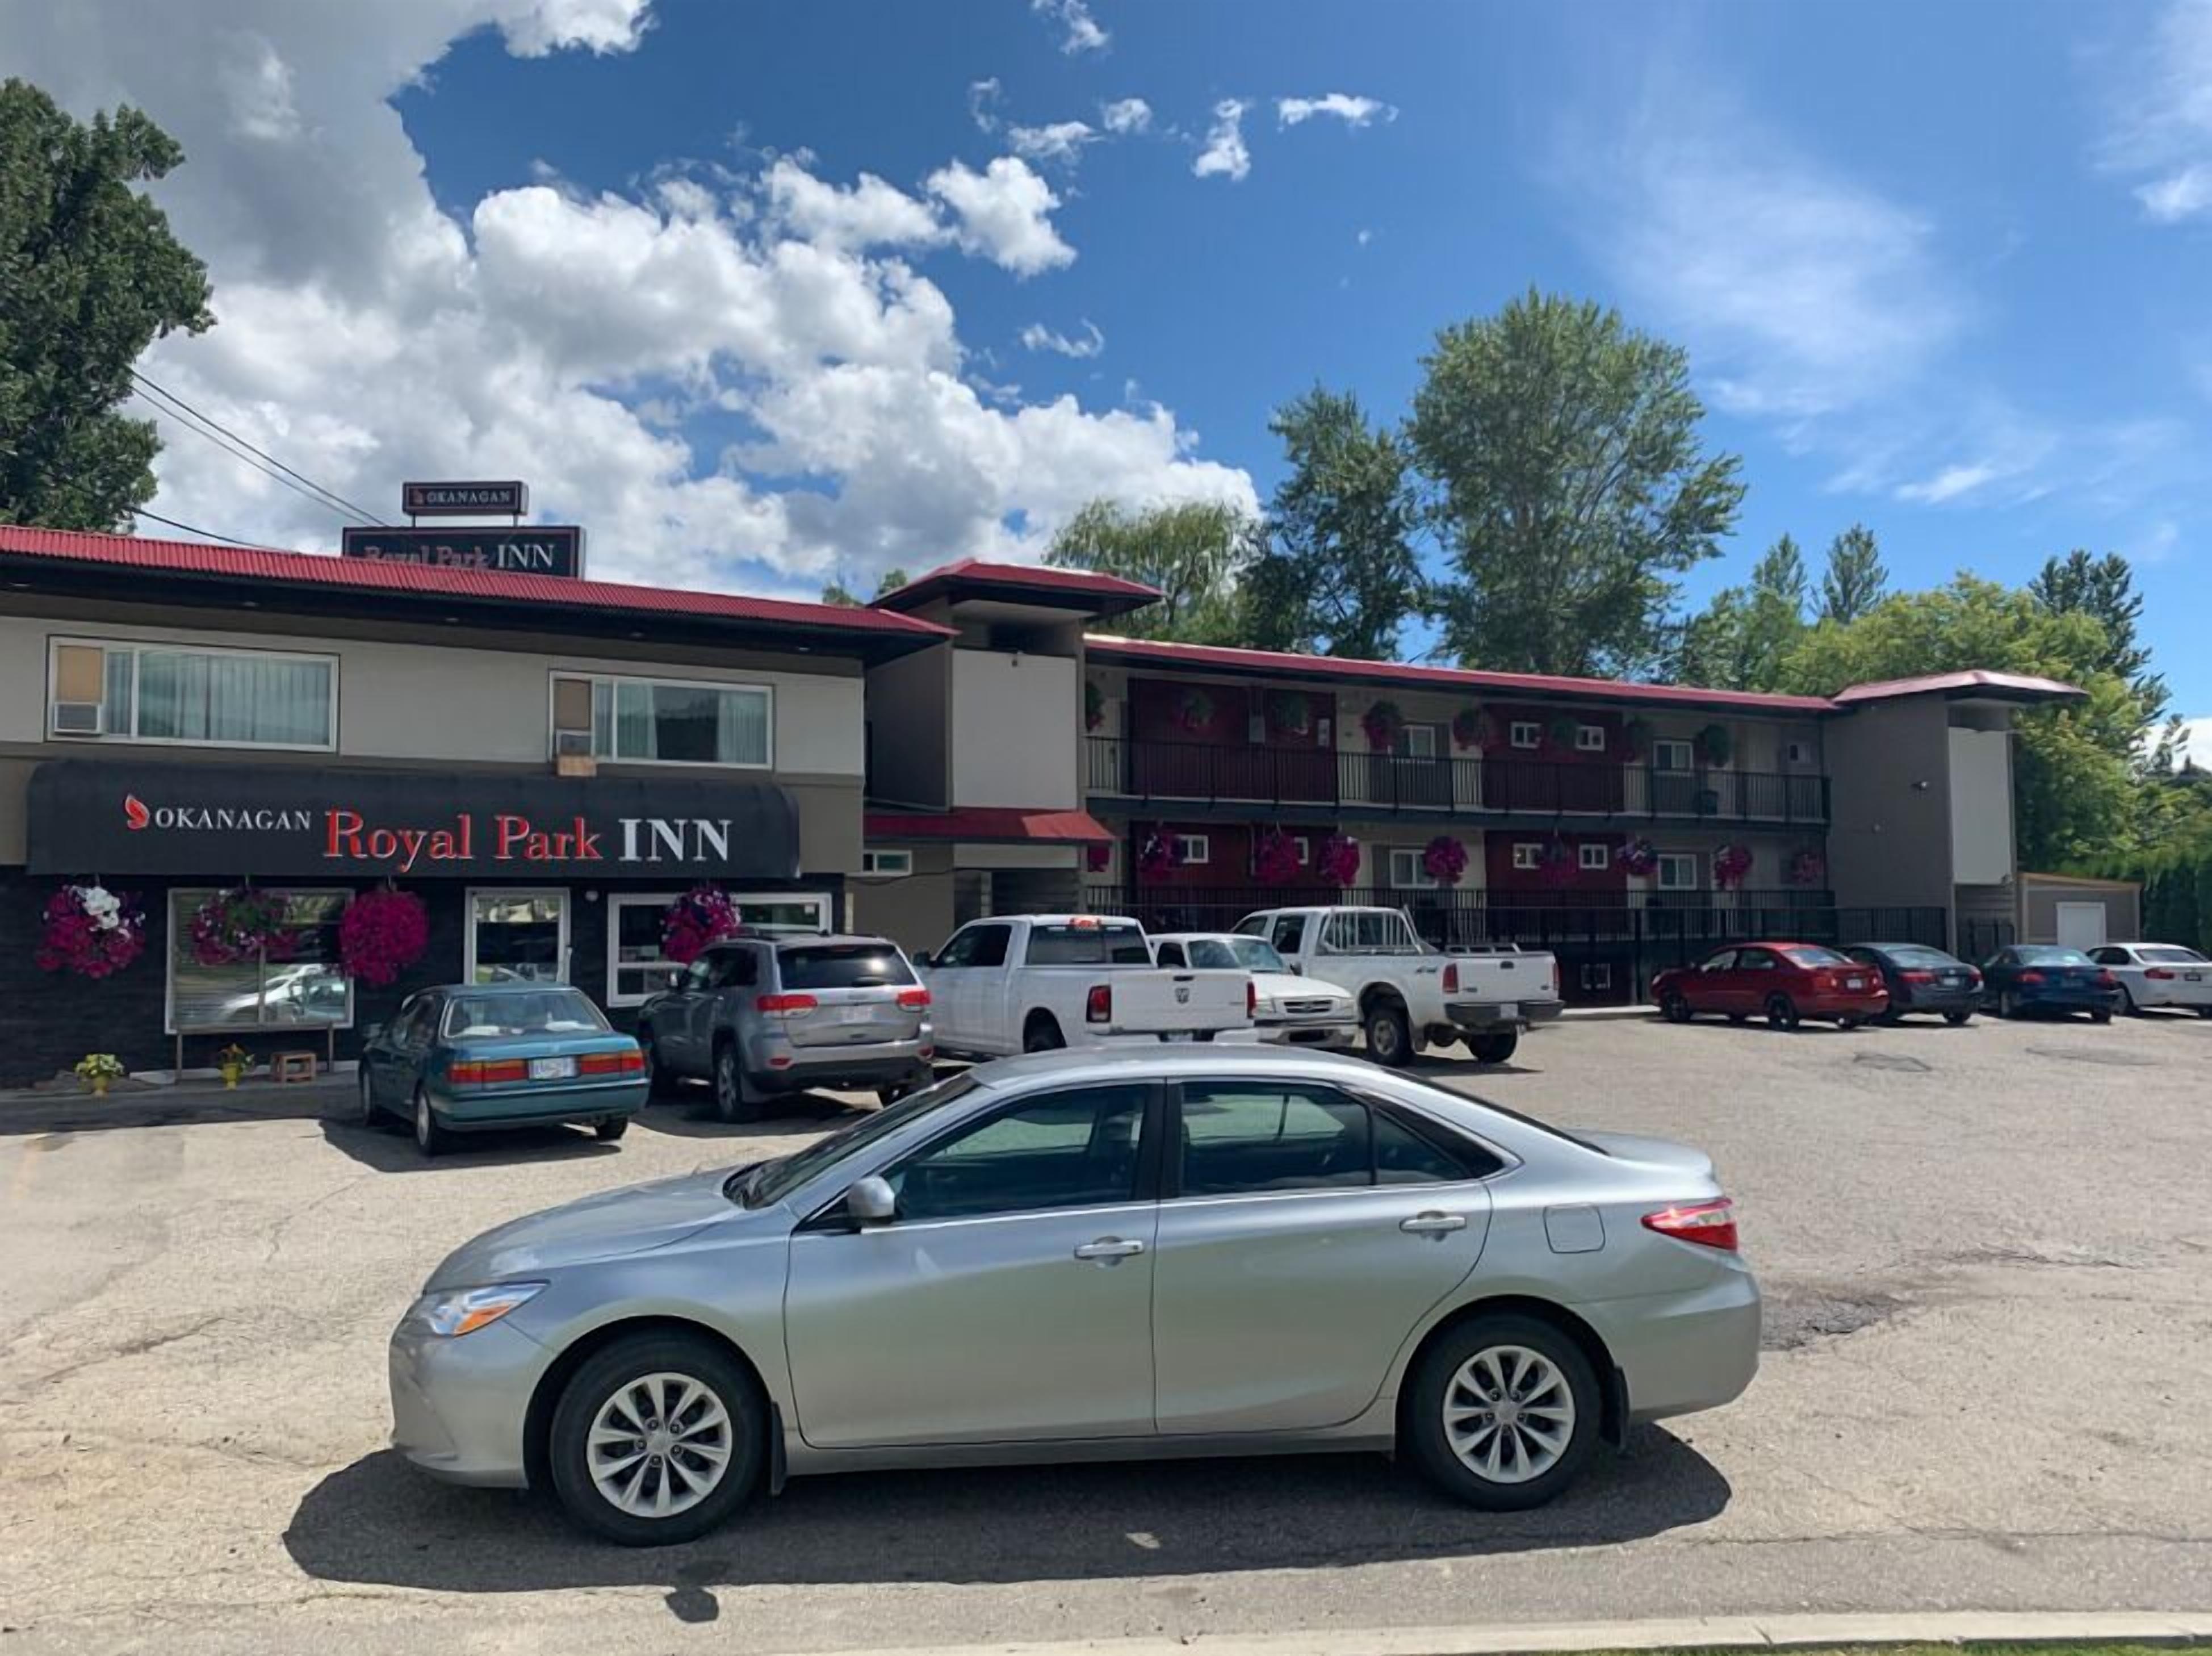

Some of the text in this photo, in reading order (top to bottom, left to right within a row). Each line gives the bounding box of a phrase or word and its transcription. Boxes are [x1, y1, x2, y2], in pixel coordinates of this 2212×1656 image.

[427, 490, 510, 503] OKANAGAN
[437, 545, 491, 568] Park
[497, 544, 555, 568] INN
[155, 808, 732, 873] OKANAGAN Royal Park INN
